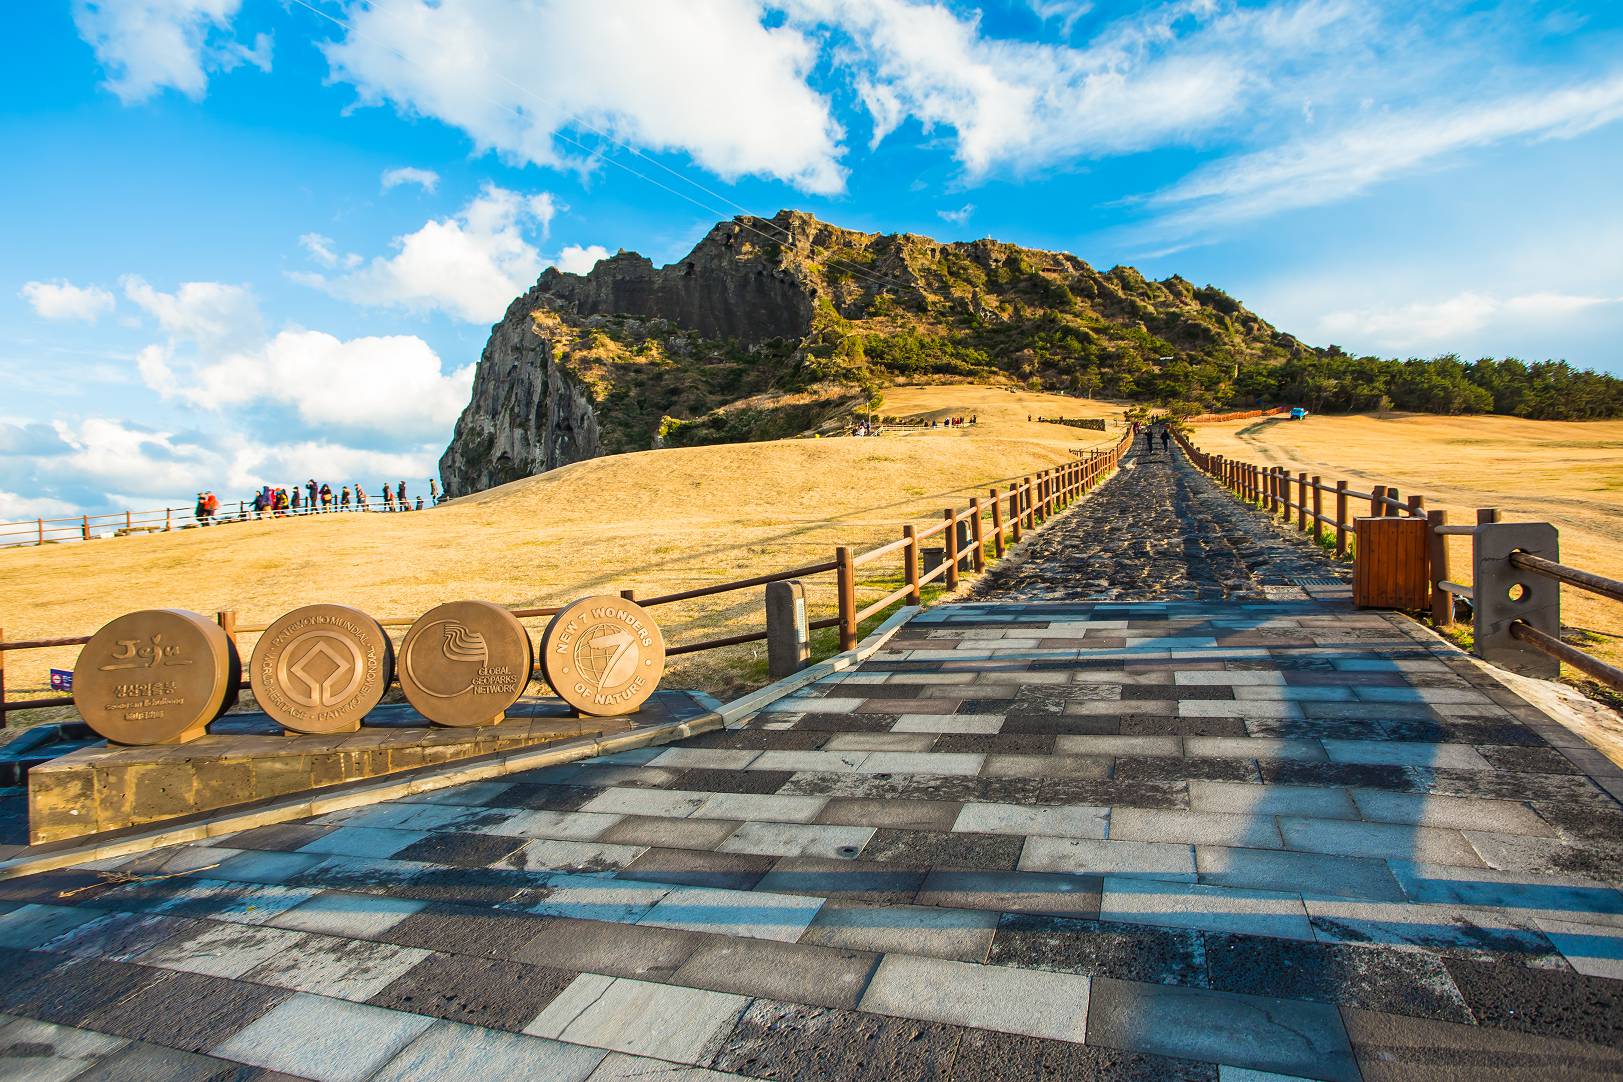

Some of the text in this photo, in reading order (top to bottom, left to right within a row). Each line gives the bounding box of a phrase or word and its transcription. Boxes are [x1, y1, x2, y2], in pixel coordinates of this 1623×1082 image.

[271, 615, 369, 647] PATRIMONIO MUNDIAL
[556, 607, 653, 655] NEW 7 WONDERS
[472, 675, 517, 686] GEOPARKS
[477, 665, 511, 676] GLOBAL
[265, 686, 308, 720] HERITAGE
[473, 684, 515, 695] NETWORK
[574, 675, 646, 705] OF NATURE
